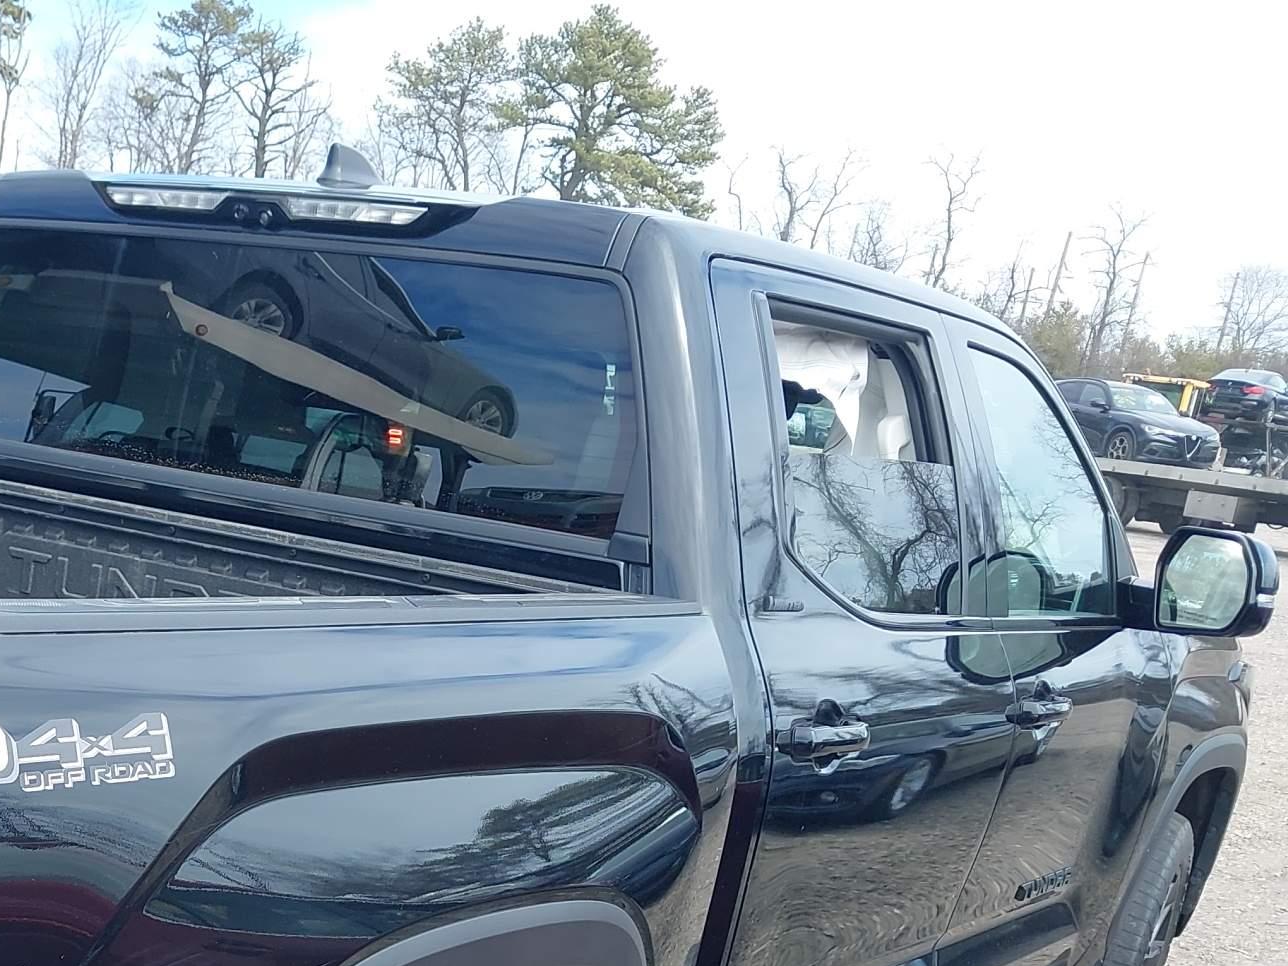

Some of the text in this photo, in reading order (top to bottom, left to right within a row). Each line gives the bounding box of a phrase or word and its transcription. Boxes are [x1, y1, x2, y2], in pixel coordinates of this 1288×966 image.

[20, 760, 176, 792] OFF ROAD
[1022, 866, 1072, 899] TUNDRA
